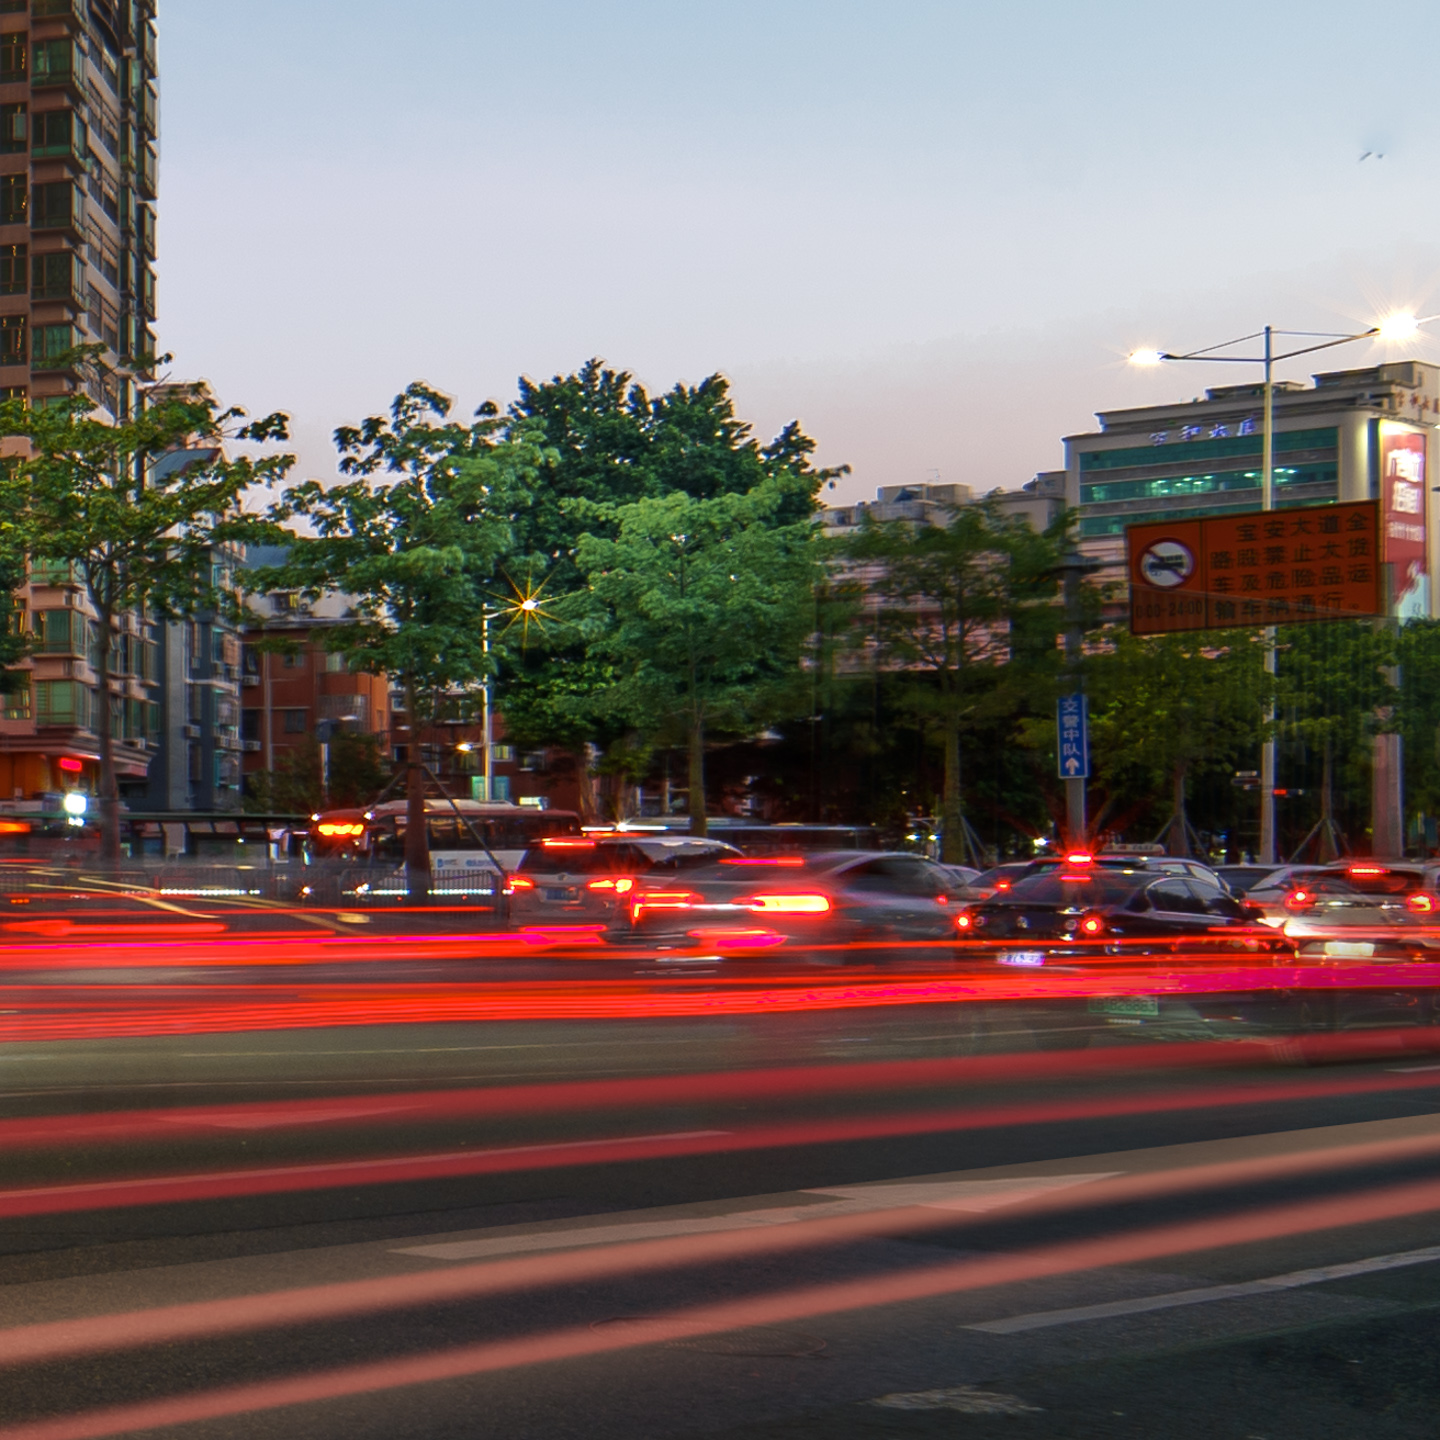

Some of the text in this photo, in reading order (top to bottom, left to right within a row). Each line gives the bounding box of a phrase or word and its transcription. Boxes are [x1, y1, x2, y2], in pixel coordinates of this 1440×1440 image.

[1235, 511, 1370, 543] 宝安大道全
[1210, 537, 1372, 570] 路段禁止大货
[1212, 563, 1373, 594] 车及危险品运
[1061, 698, 1081, 756] 交警中队
